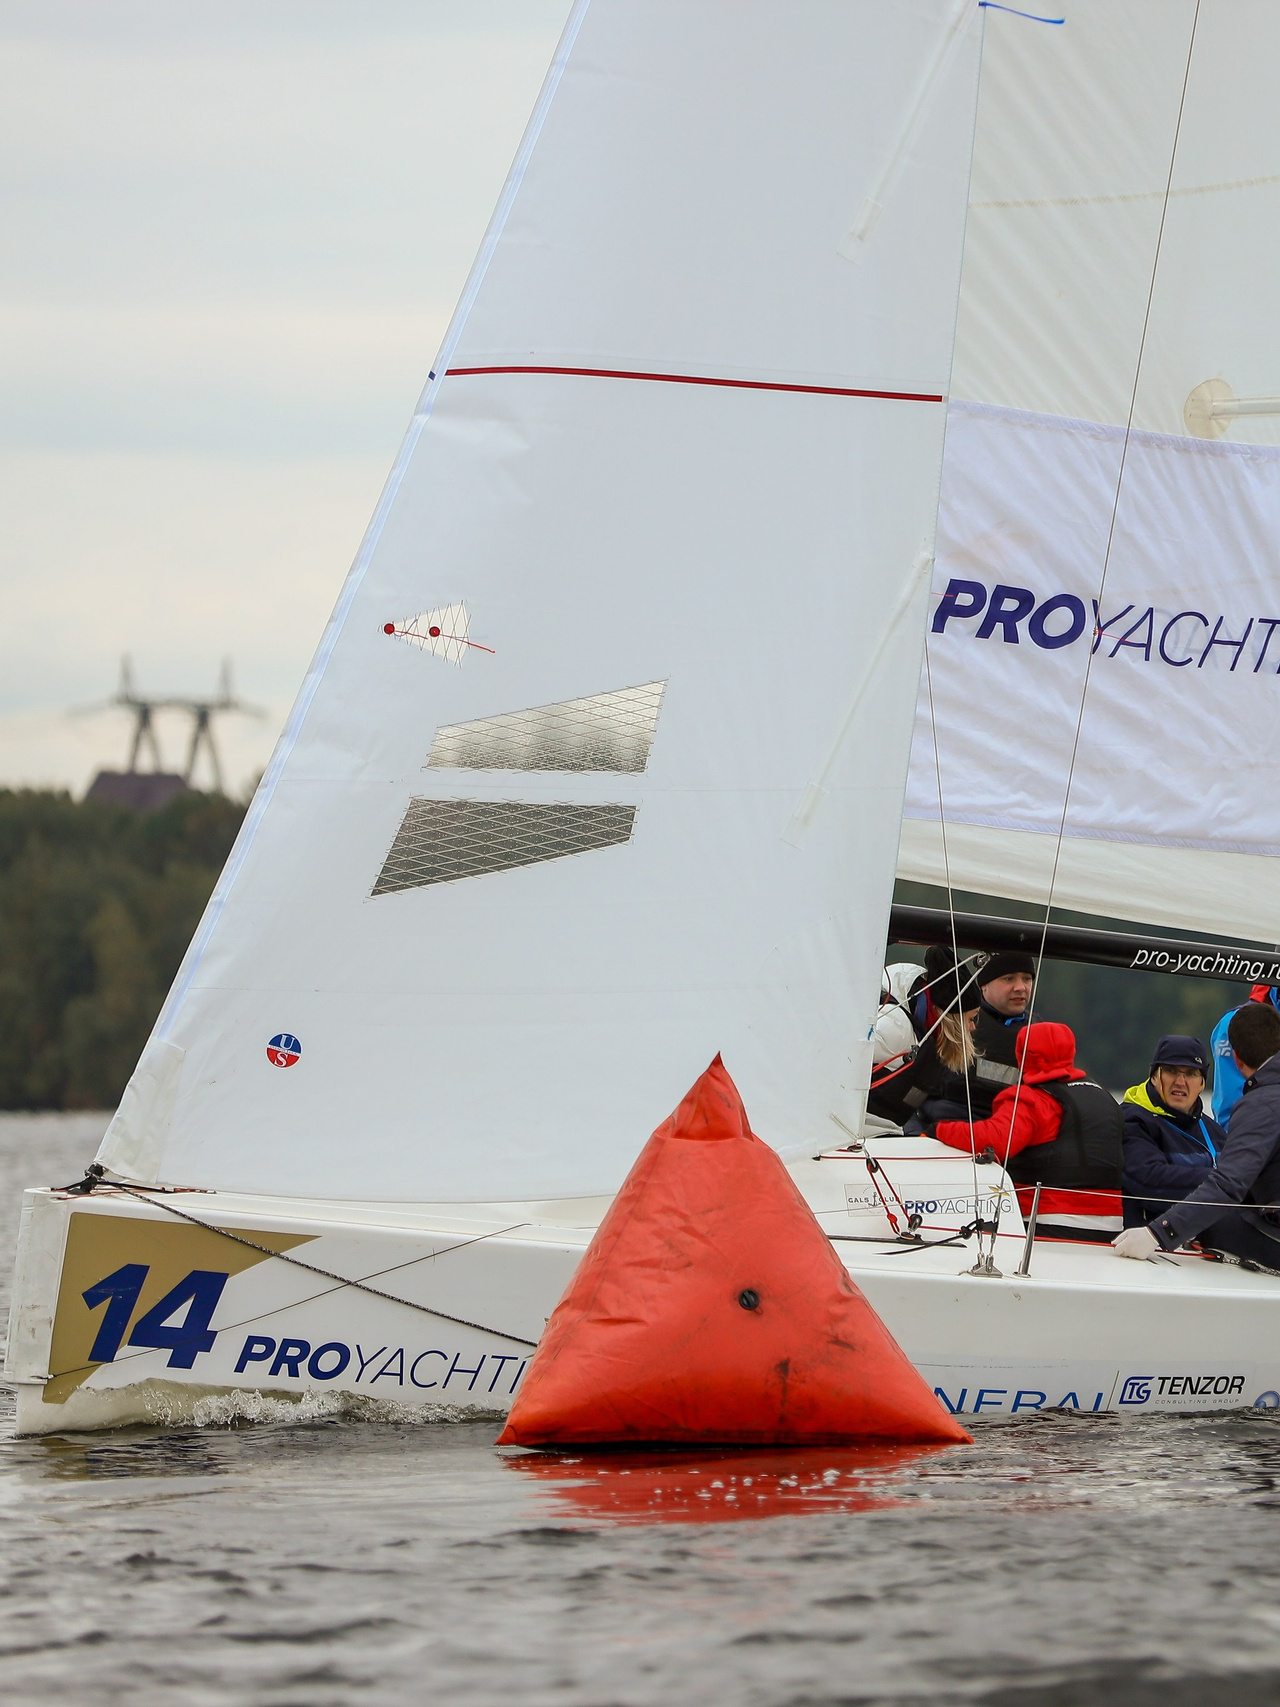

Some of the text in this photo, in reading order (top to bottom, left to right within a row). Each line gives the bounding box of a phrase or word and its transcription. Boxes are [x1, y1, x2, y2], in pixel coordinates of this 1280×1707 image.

[81, 1262, 229, 1370] 14
[234, 1335, 527, 1394] PROYACHTI
[1157, 1375, 1246, 1395] TENZOR
